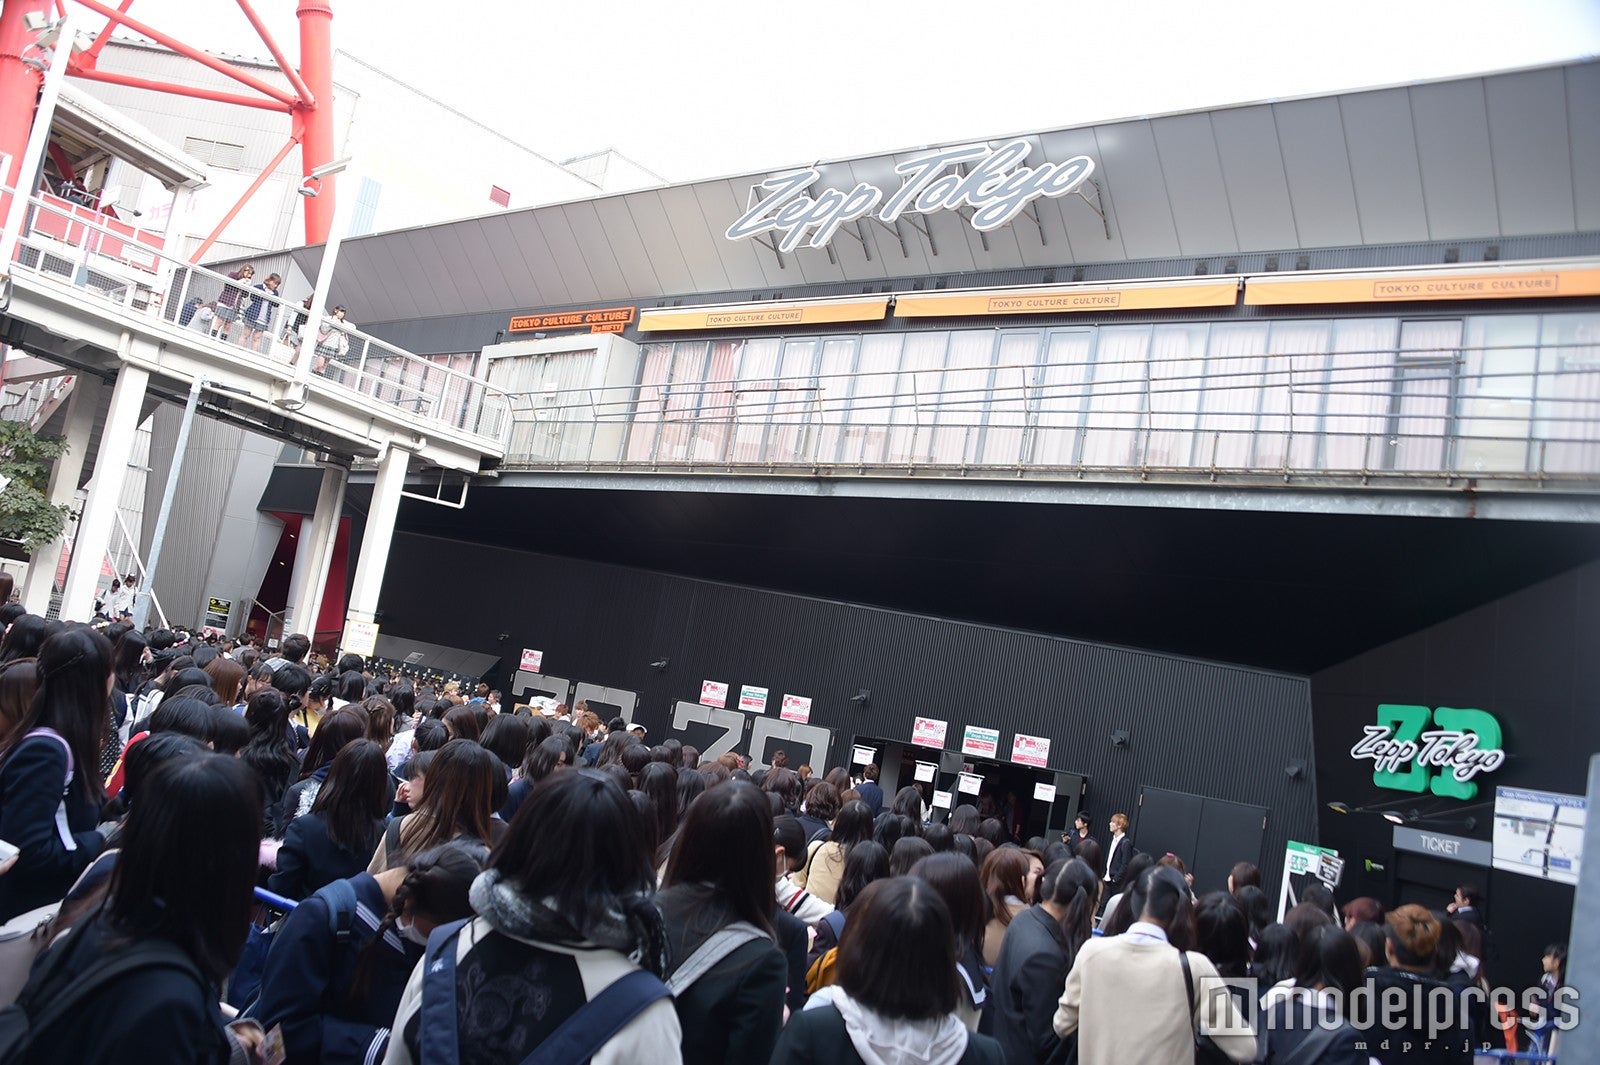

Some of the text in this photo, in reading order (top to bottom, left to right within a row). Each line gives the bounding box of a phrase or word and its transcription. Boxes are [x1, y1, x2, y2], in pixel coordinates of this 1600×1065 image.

[725, 140, 1095, 252] Zepp Tokyo
[1379, 279, 1551, 293] TOKYO CULTURE CULTURE
[993, 296, 1117, 308] TOKYO CULTURE CULTURE
[512, 311, 629, 328] TOKYO CULTURE CULTURE
[734, 314, 764, 322] CULTURE
[767, 312, 800, 320] CULTURE
[1351, 725, 1505, 782] Zepp Tokyo
[1420, 835, 1461, 854] TICKET
